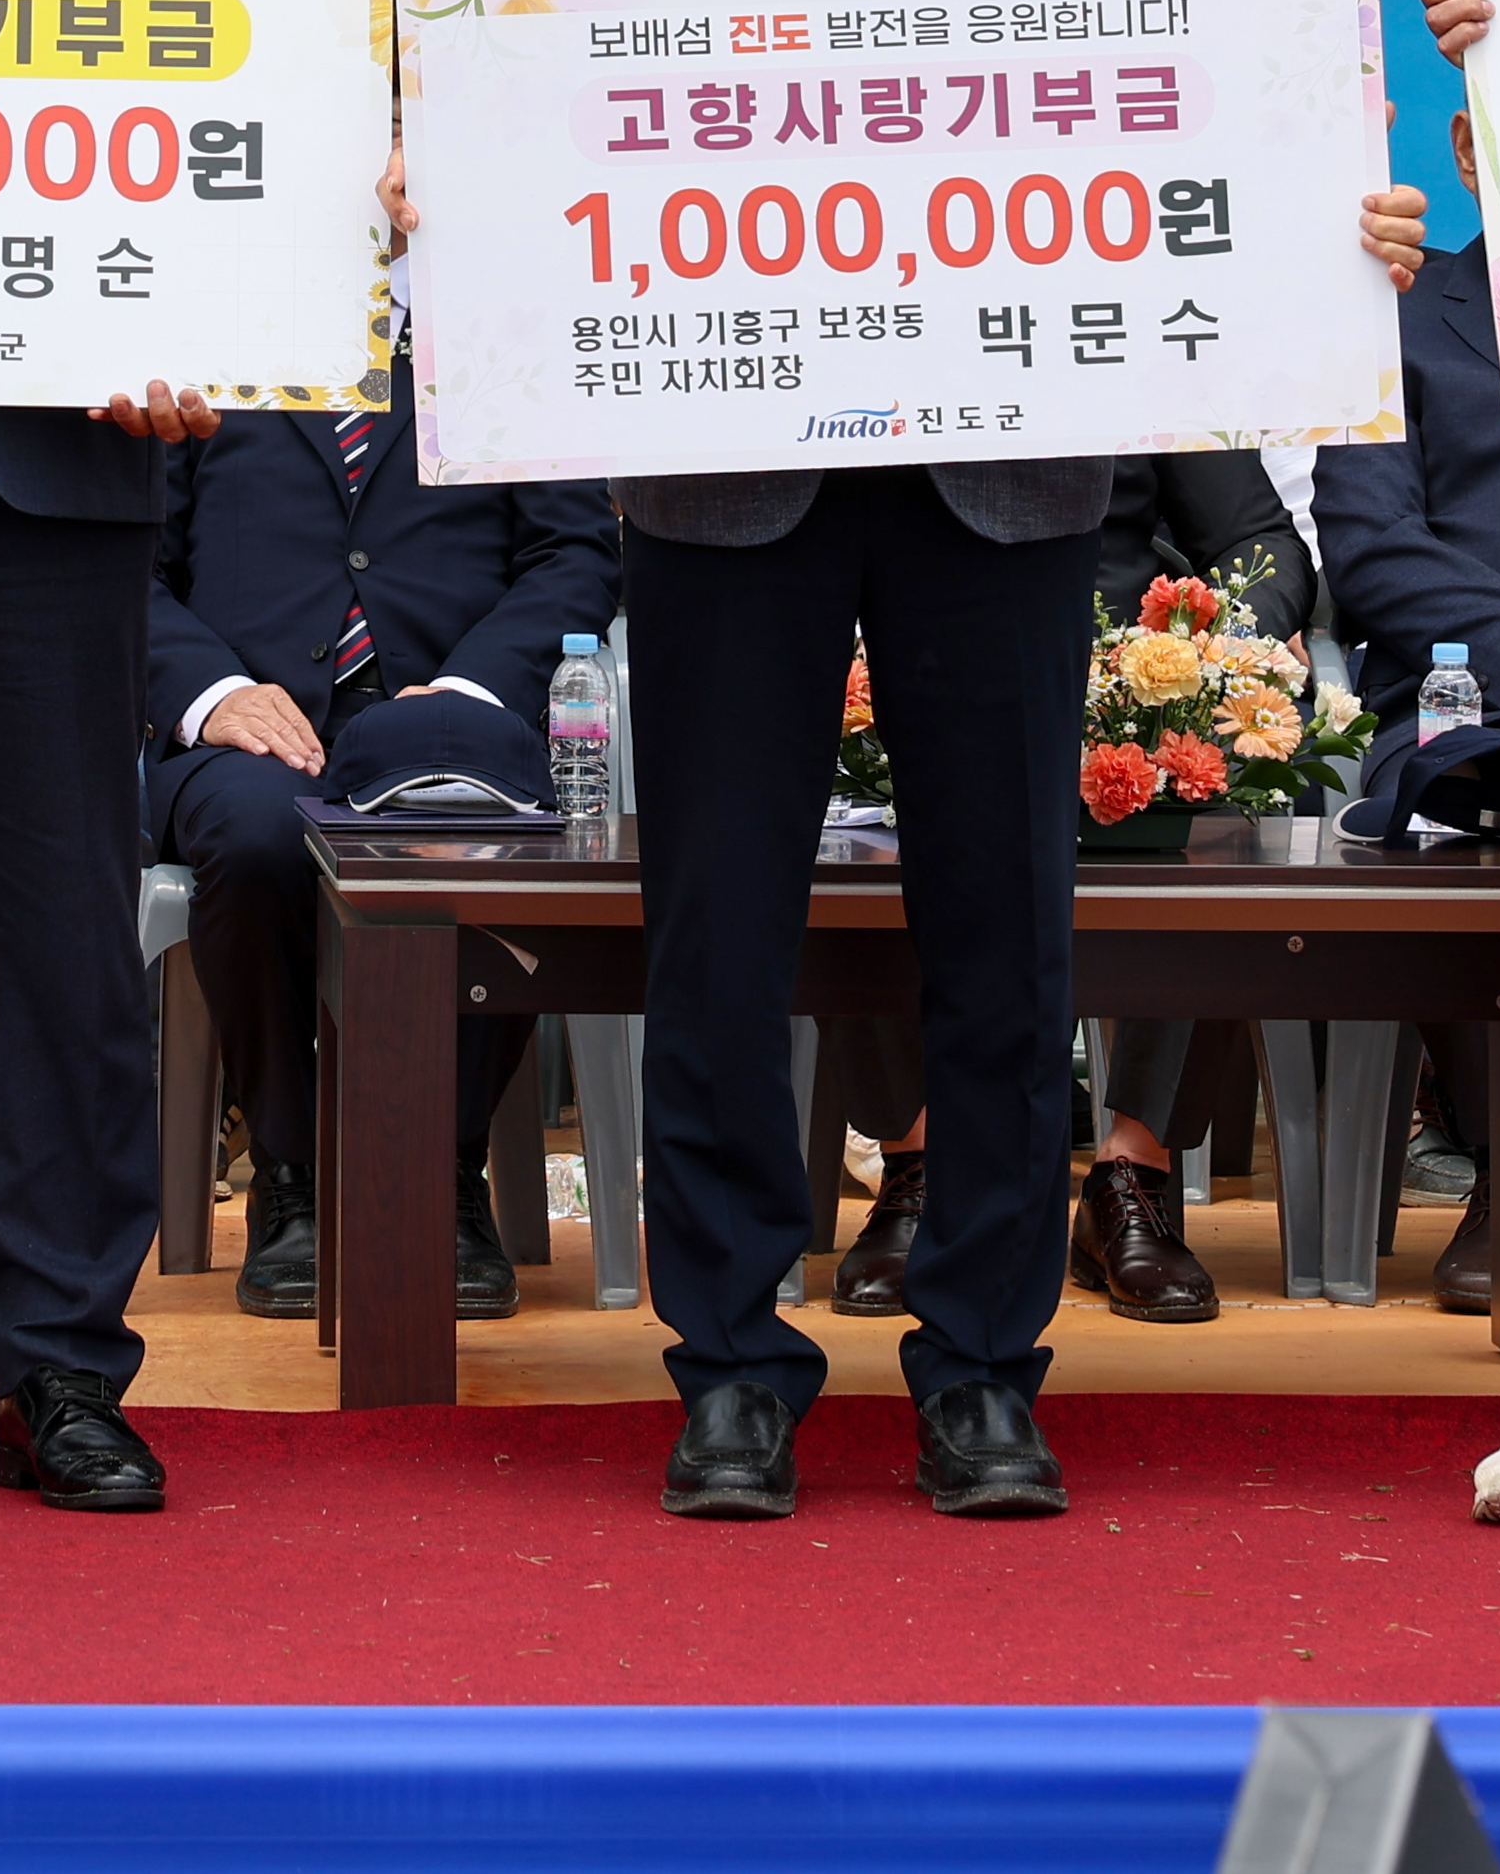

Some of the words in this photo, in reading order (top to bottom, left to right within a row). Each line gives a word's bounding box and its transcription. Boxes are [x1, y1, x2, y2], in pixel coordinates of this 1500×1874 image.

[590, 17, 710, 57] 보배섬
[730, 14, 810, 53] 진도
[828, 8, 950, 49] 발전을
[608, 67, 1179, 151] 고향사랑기부금
[564, 171, 1232, 298] 1,000,000원
[572, 314, 675, 352] 용인시
[696, 309, 799, 345] 기흥구
[820, 304, 923, 340] 보정동
[575, 362, 641, 397] 주민
[662, 355, 803, 393] 자치회장
